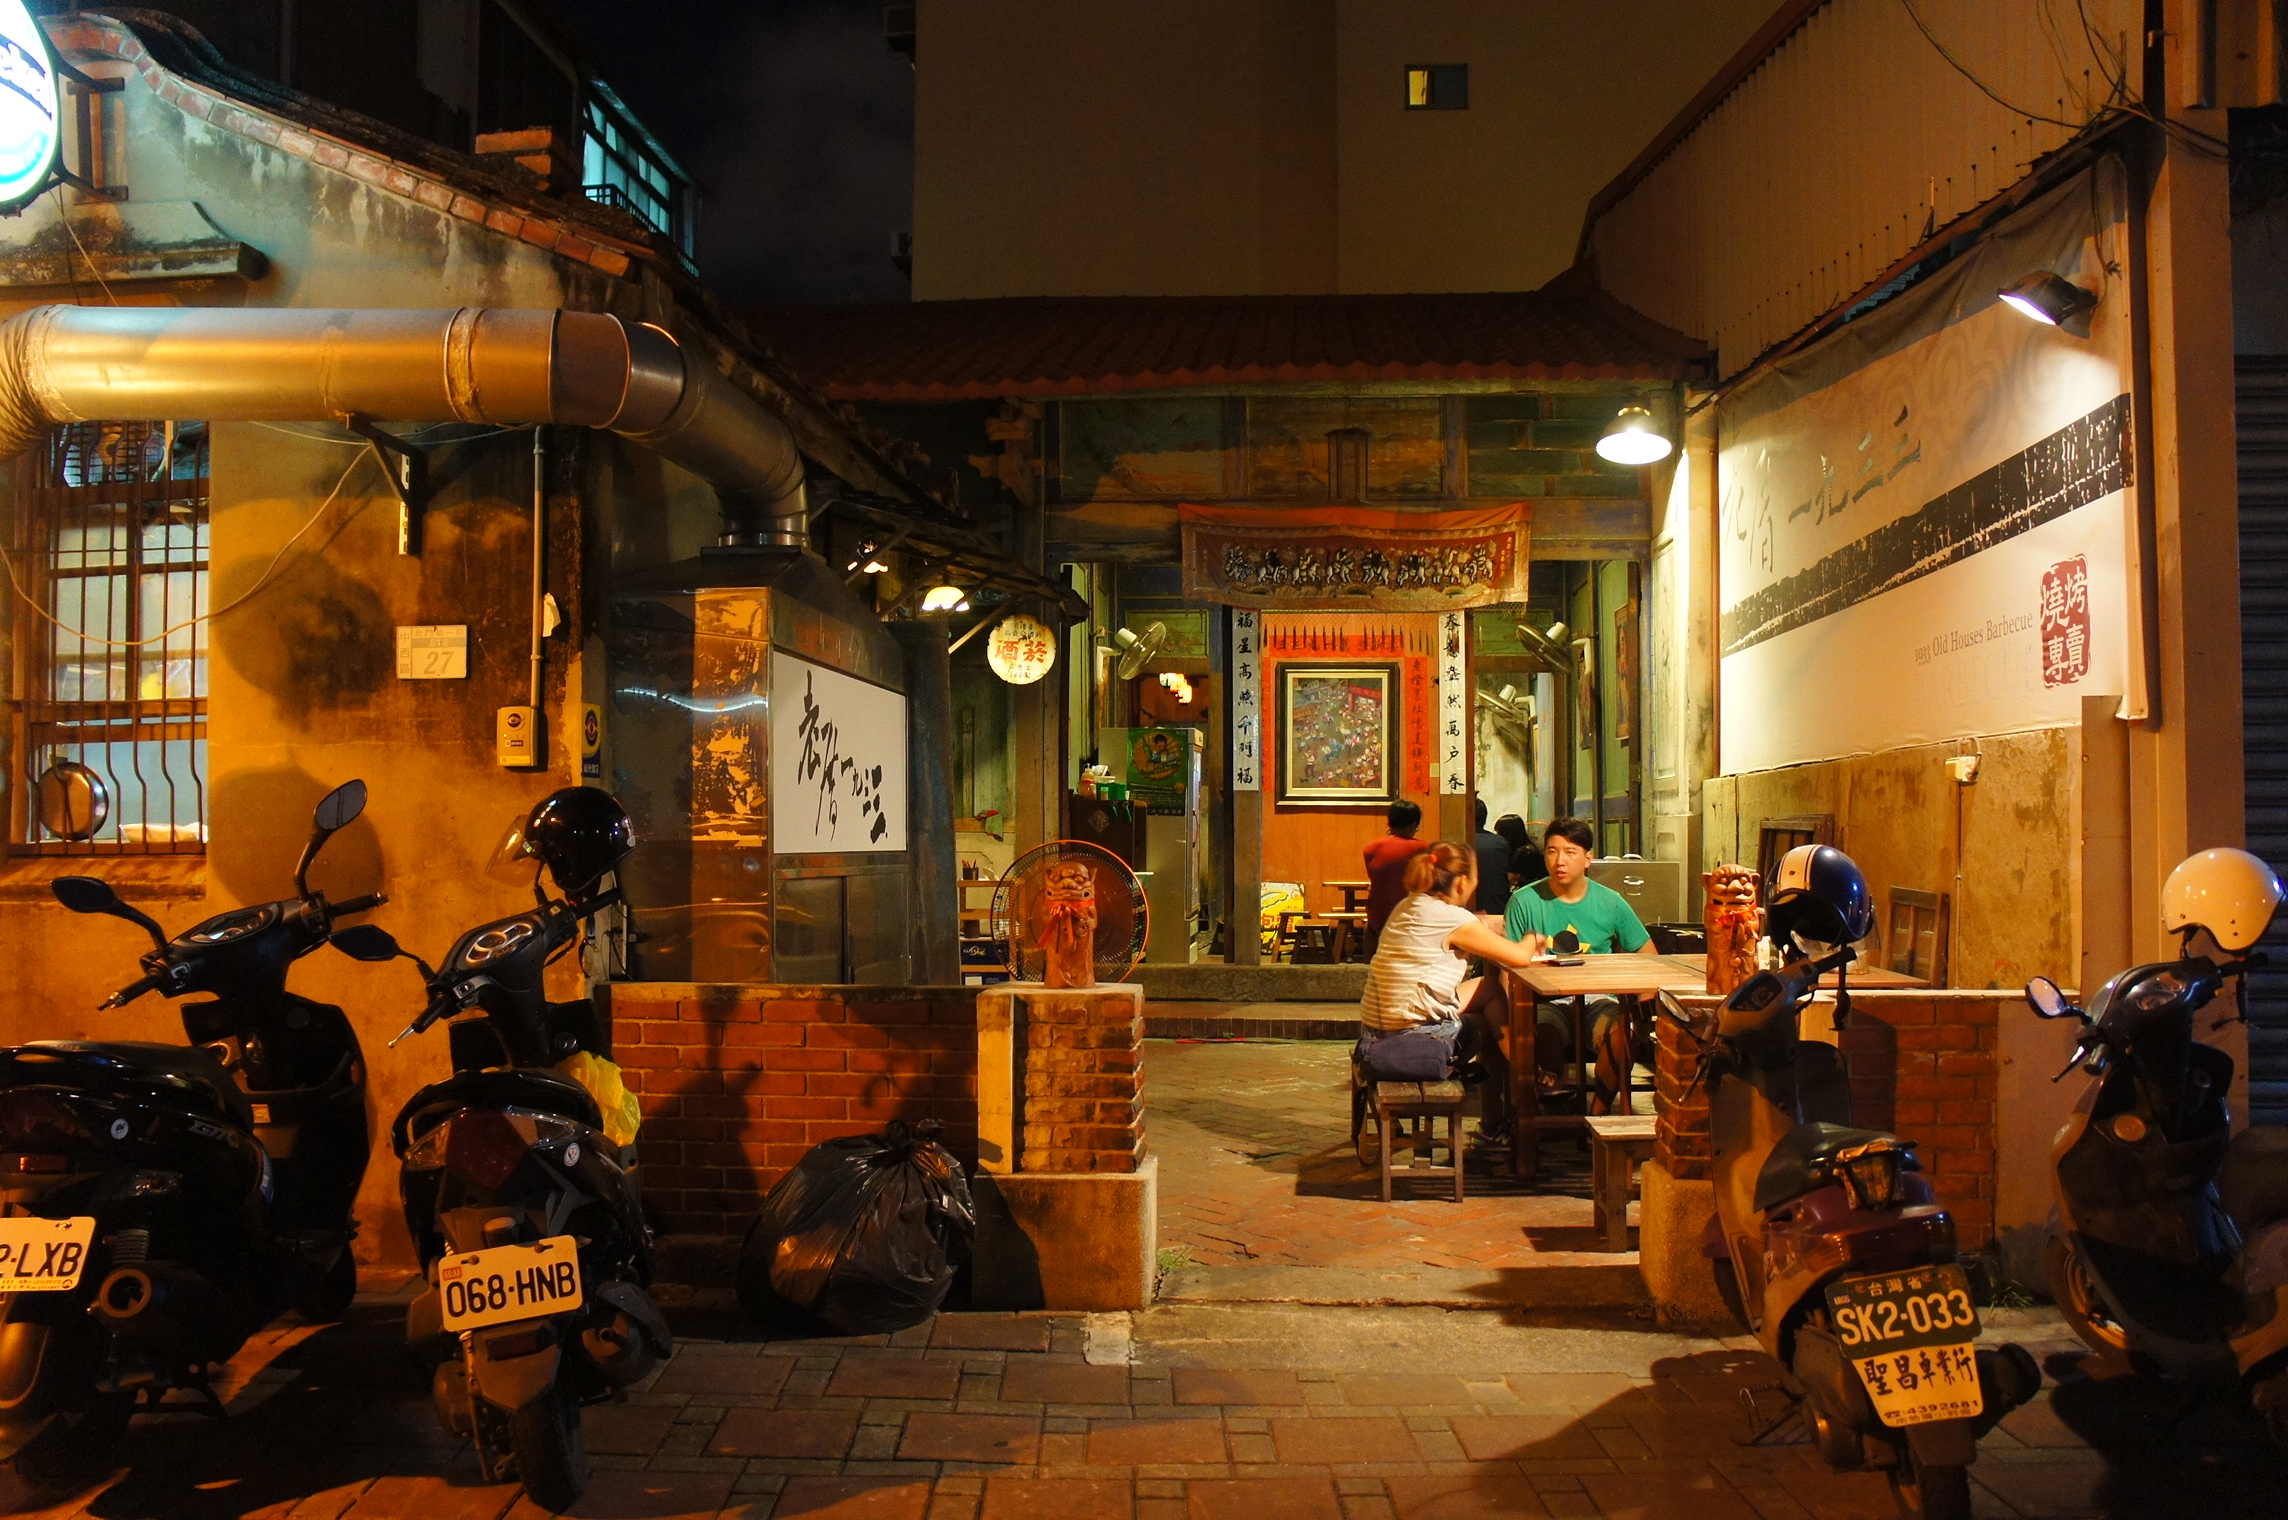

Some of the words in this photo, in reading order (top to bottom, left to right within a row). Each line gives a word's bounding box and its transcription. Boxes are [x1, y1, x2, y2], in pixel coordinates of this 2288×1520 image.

[424, 651, 454, 674] 27
[1914, 645, 1931, 666] 1933
[1932, 633, 1948, 657] Old
[1950, 628, 1984, 652] Houses
[1986, 612, 2034, 642] Barbecue
[2045, 622, 2086, 681] 專賣
[1236, 611, 1254, 785] 福星高照千門福
[446, 1261, 576, 1318] 068-HNB
[1868, 1276, 1923, 1297] 台灣省
[1836, 1289, 1974, 1345] SK2-033
